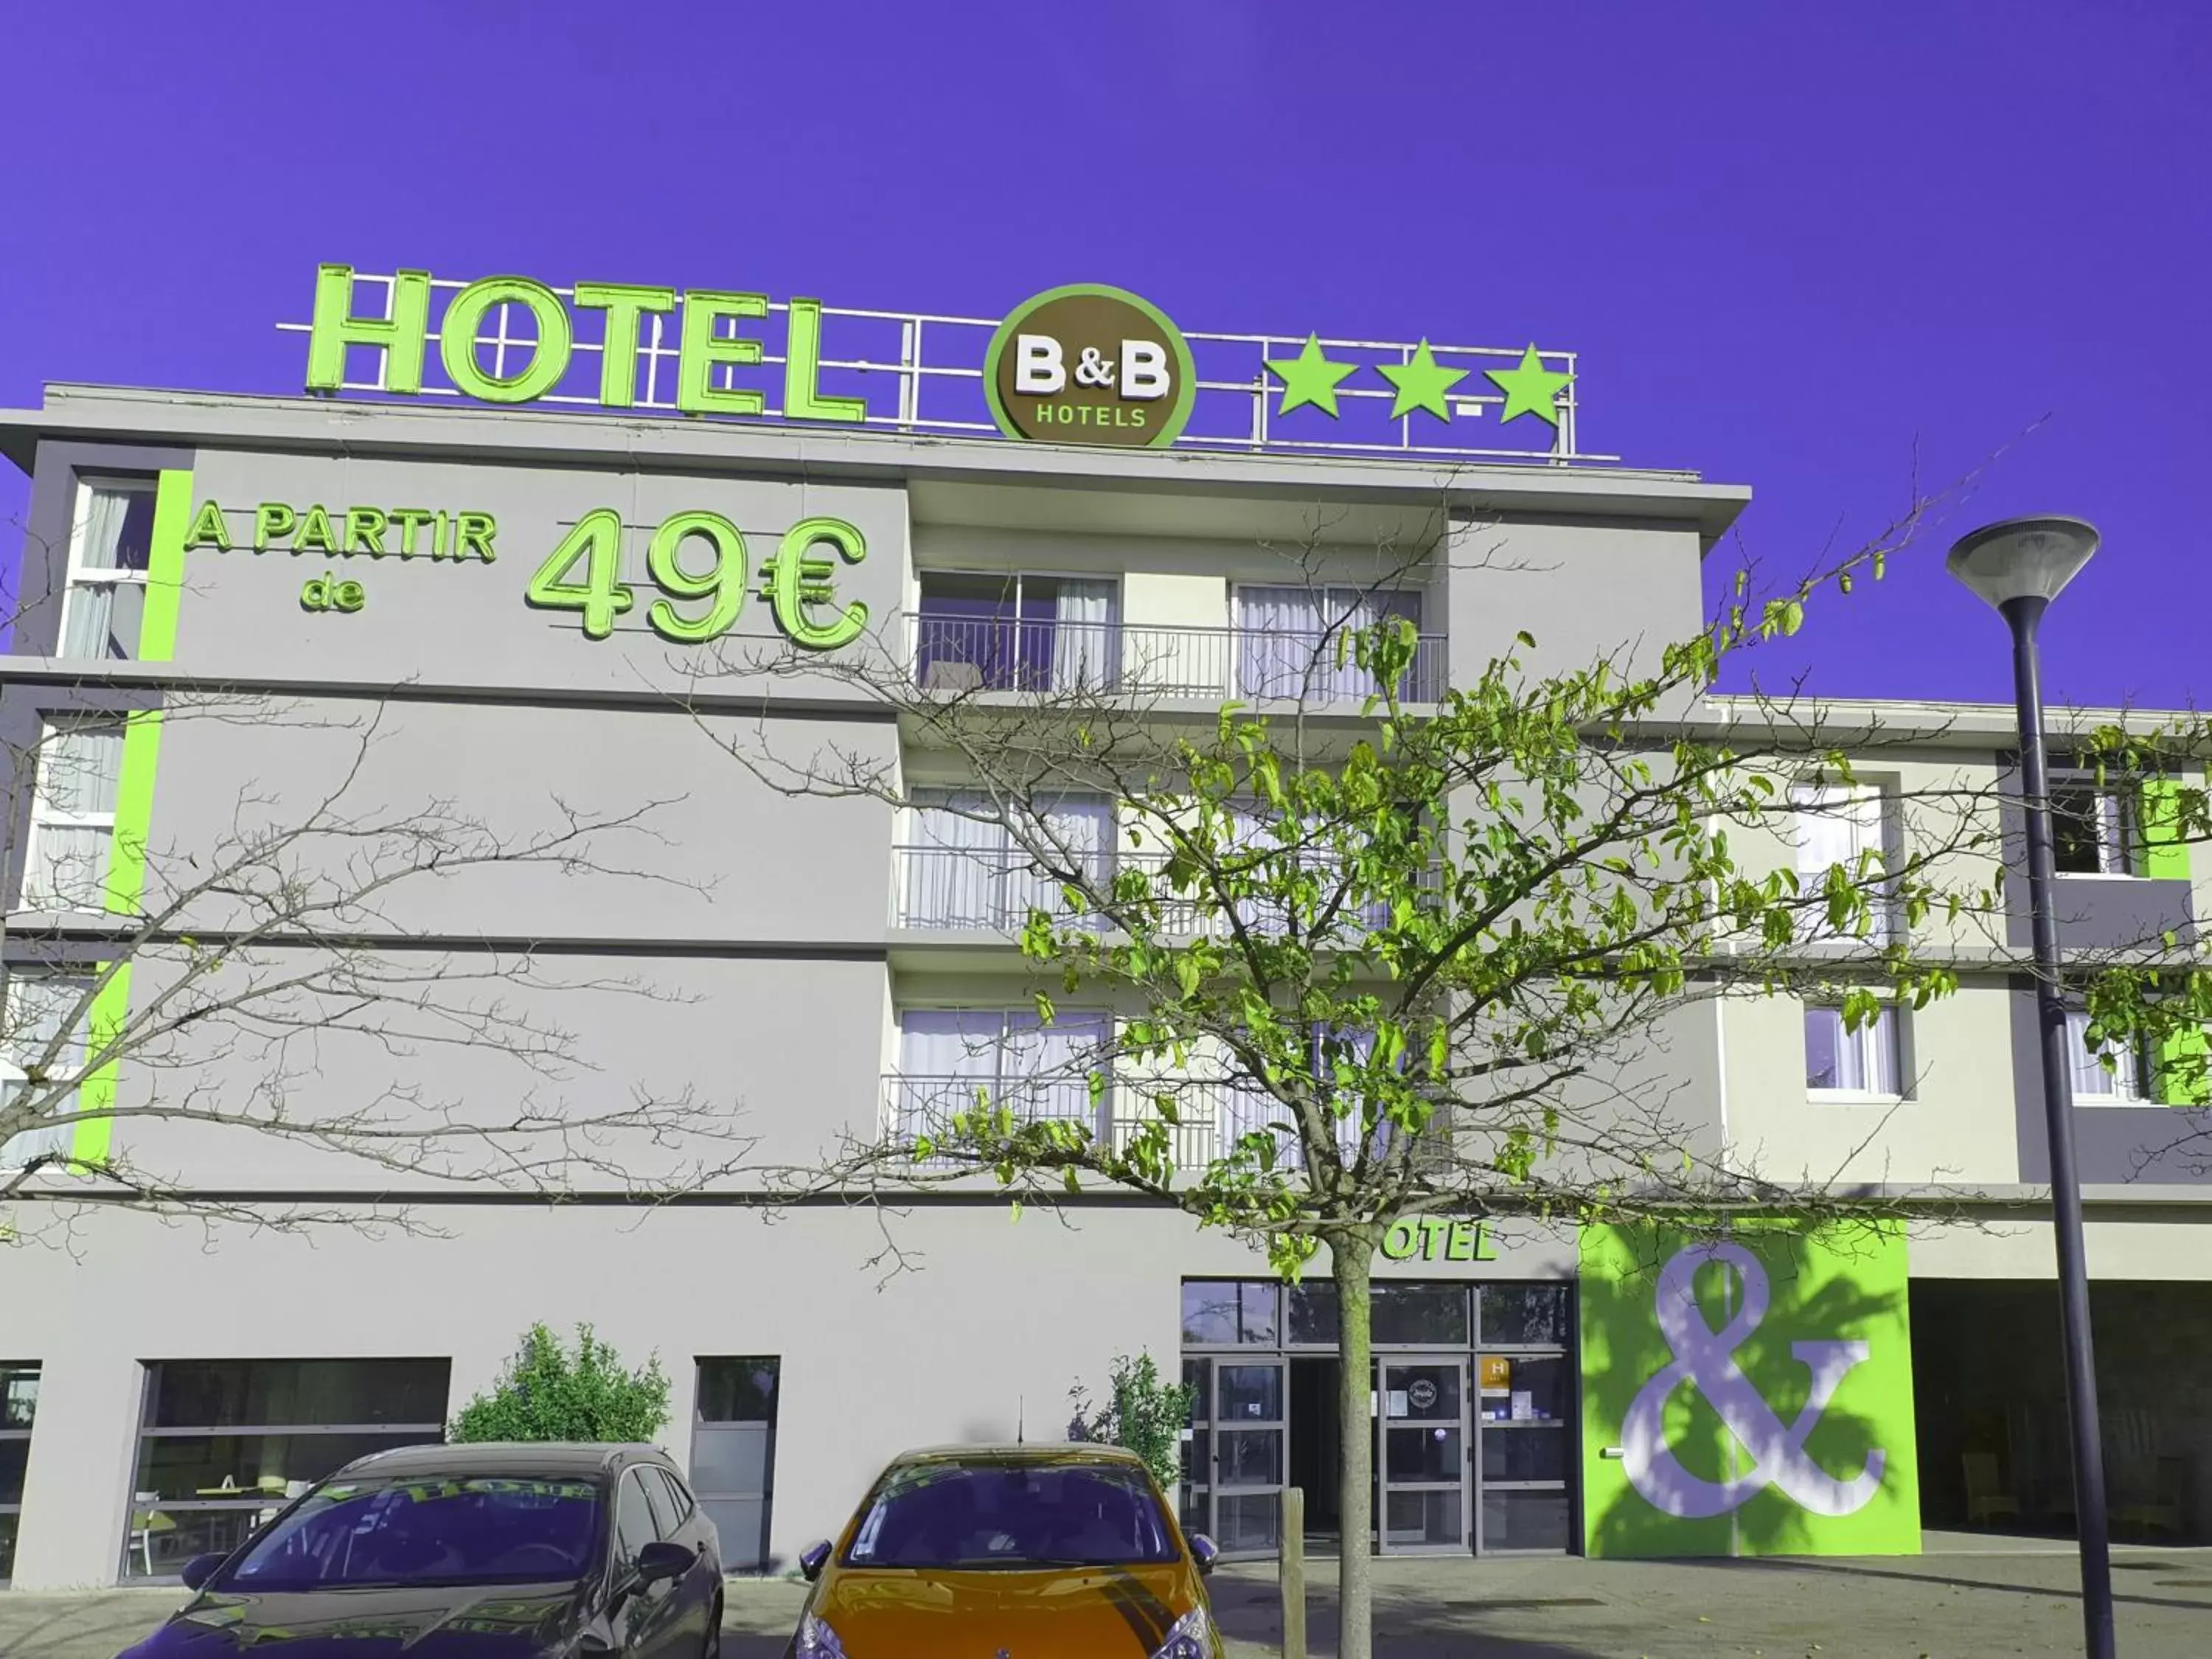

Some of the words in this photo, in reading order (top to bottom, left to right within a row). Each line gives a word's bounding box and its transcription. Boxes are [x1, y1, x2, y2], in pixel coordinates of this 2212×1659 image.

[306, 263, 866, 422] HOTEL
[1037, 404, 1145, 427] HOTELS
[184, 500, 232, 552] A
[254, 502, 497, 563] PARTIR
[299, 571, 364, 612] de
[524, 507, 869, 650] 49€
[1380, 1216, 1498, 1262] OTEL
